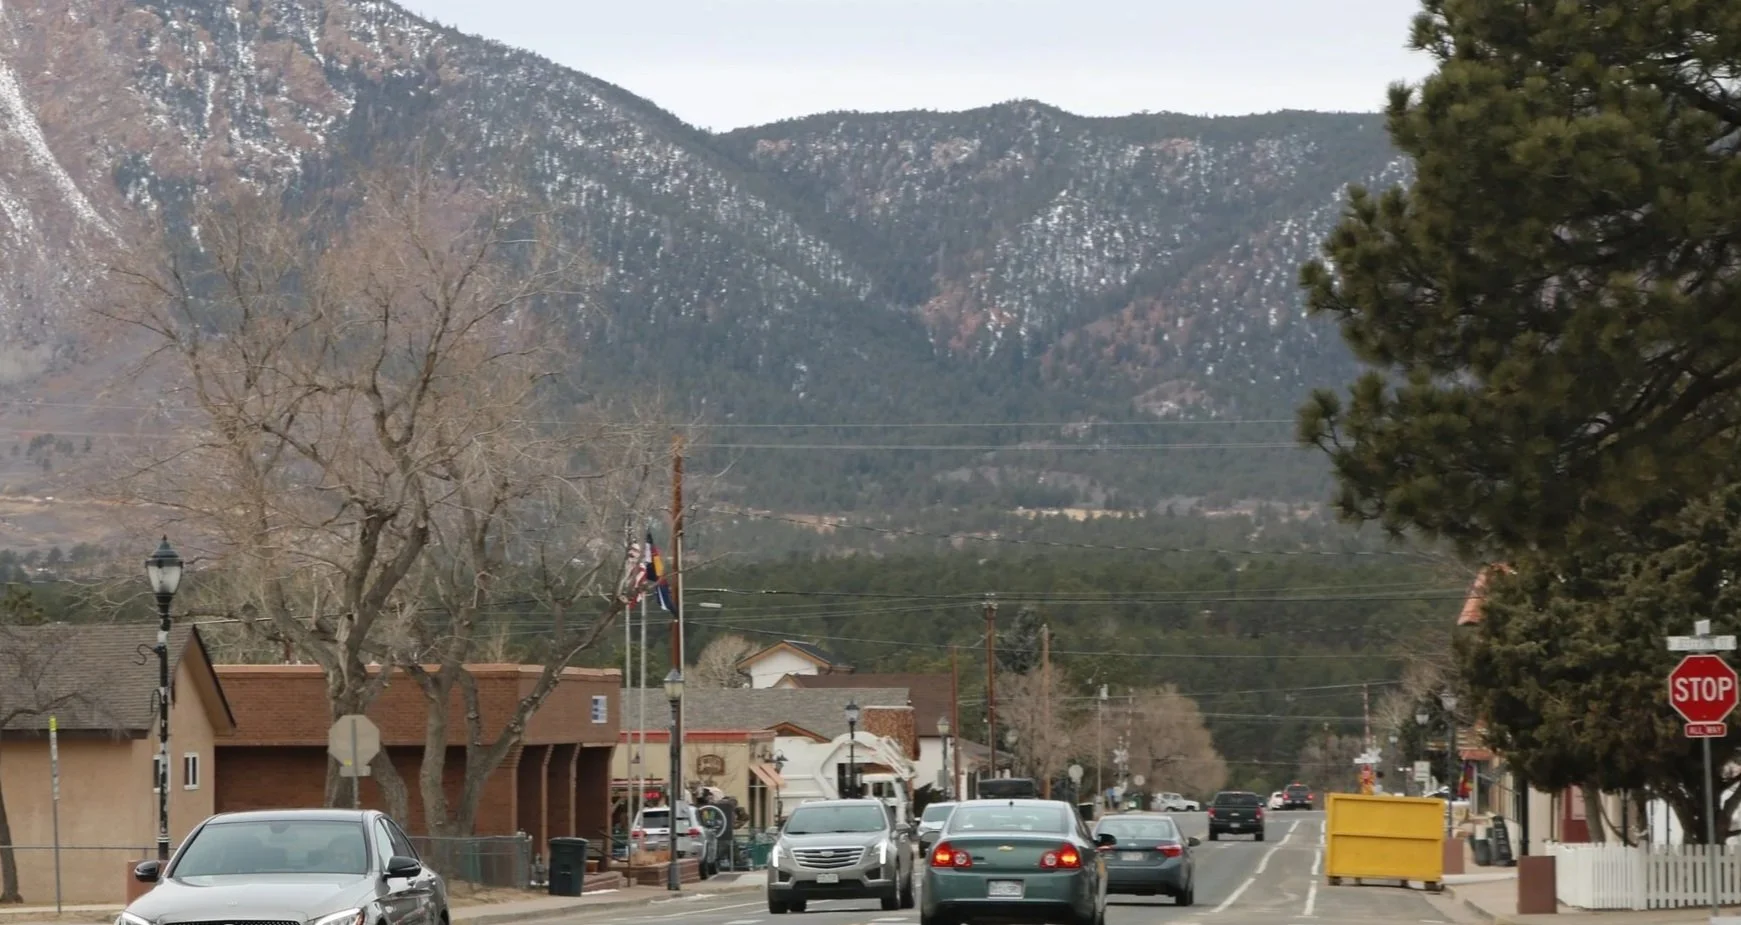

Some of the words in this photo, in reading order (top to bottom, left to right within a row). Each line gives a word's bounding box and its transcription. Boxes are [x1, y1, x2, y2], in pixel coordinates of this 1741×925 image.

[1674, 676, 1733, 702] STOP
[1689, 726, 1703, 734] ALL
[1705, 725, 1722, 734] WAY
